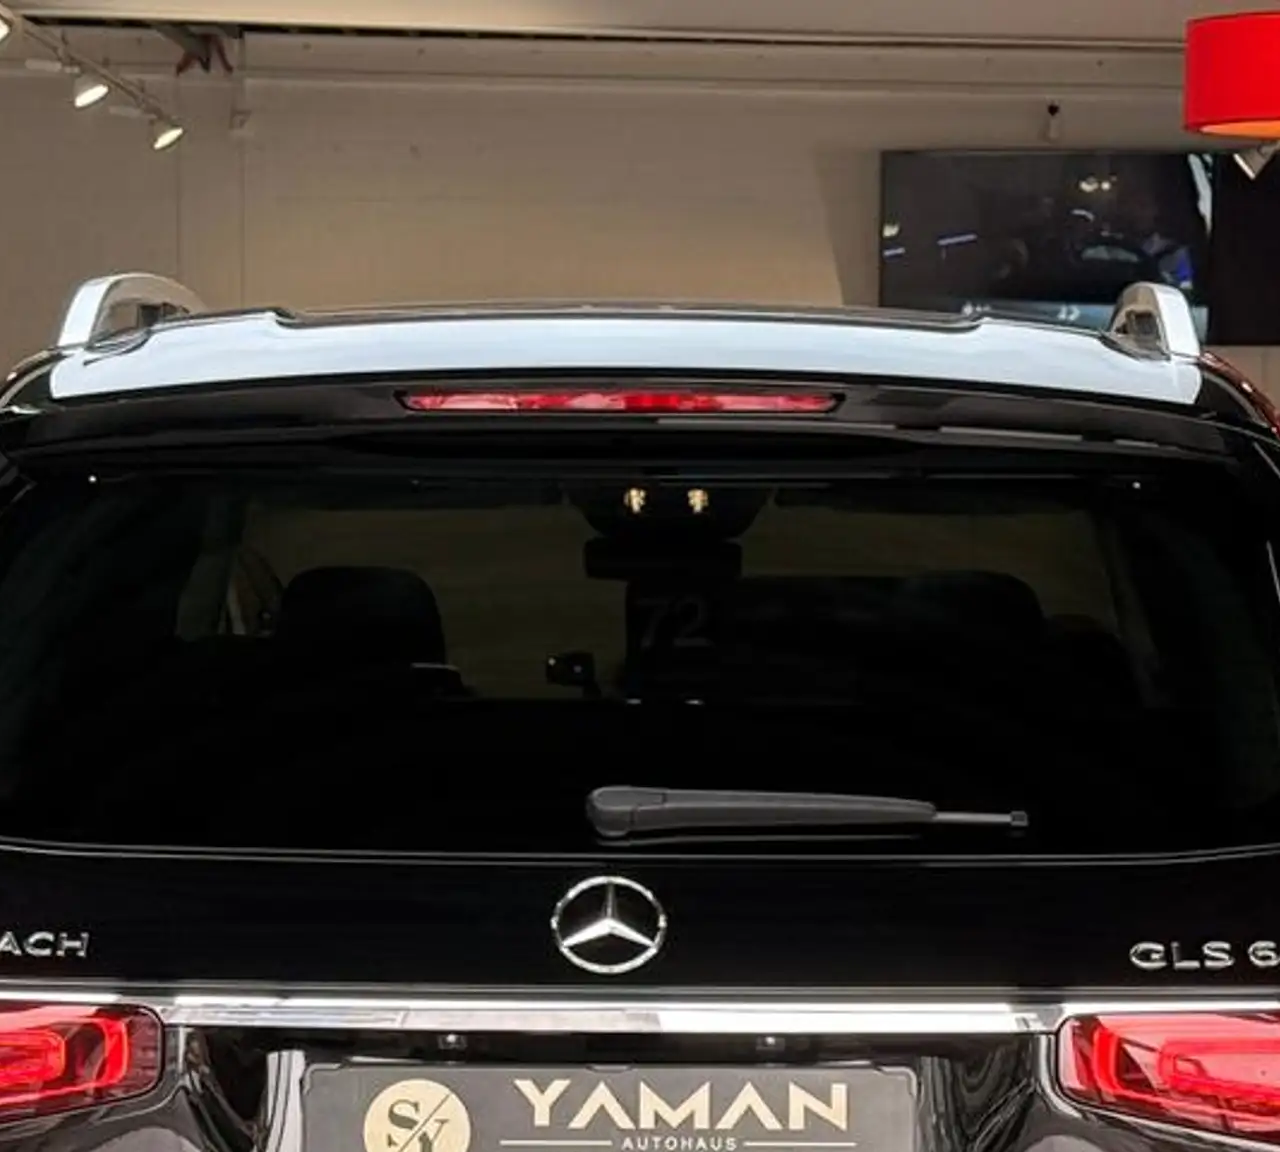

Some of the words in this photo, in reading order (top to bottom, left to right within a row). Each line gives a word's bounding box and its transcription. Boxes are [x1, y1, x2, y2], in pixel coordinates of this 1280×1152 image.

[638, 597, 715, 650] 72
[1129, 940, 1236, 969] GLS
[513, 1079, 848, 1132] YAMAN
[621, 1136, 738, 1152] AUTOHAUS
